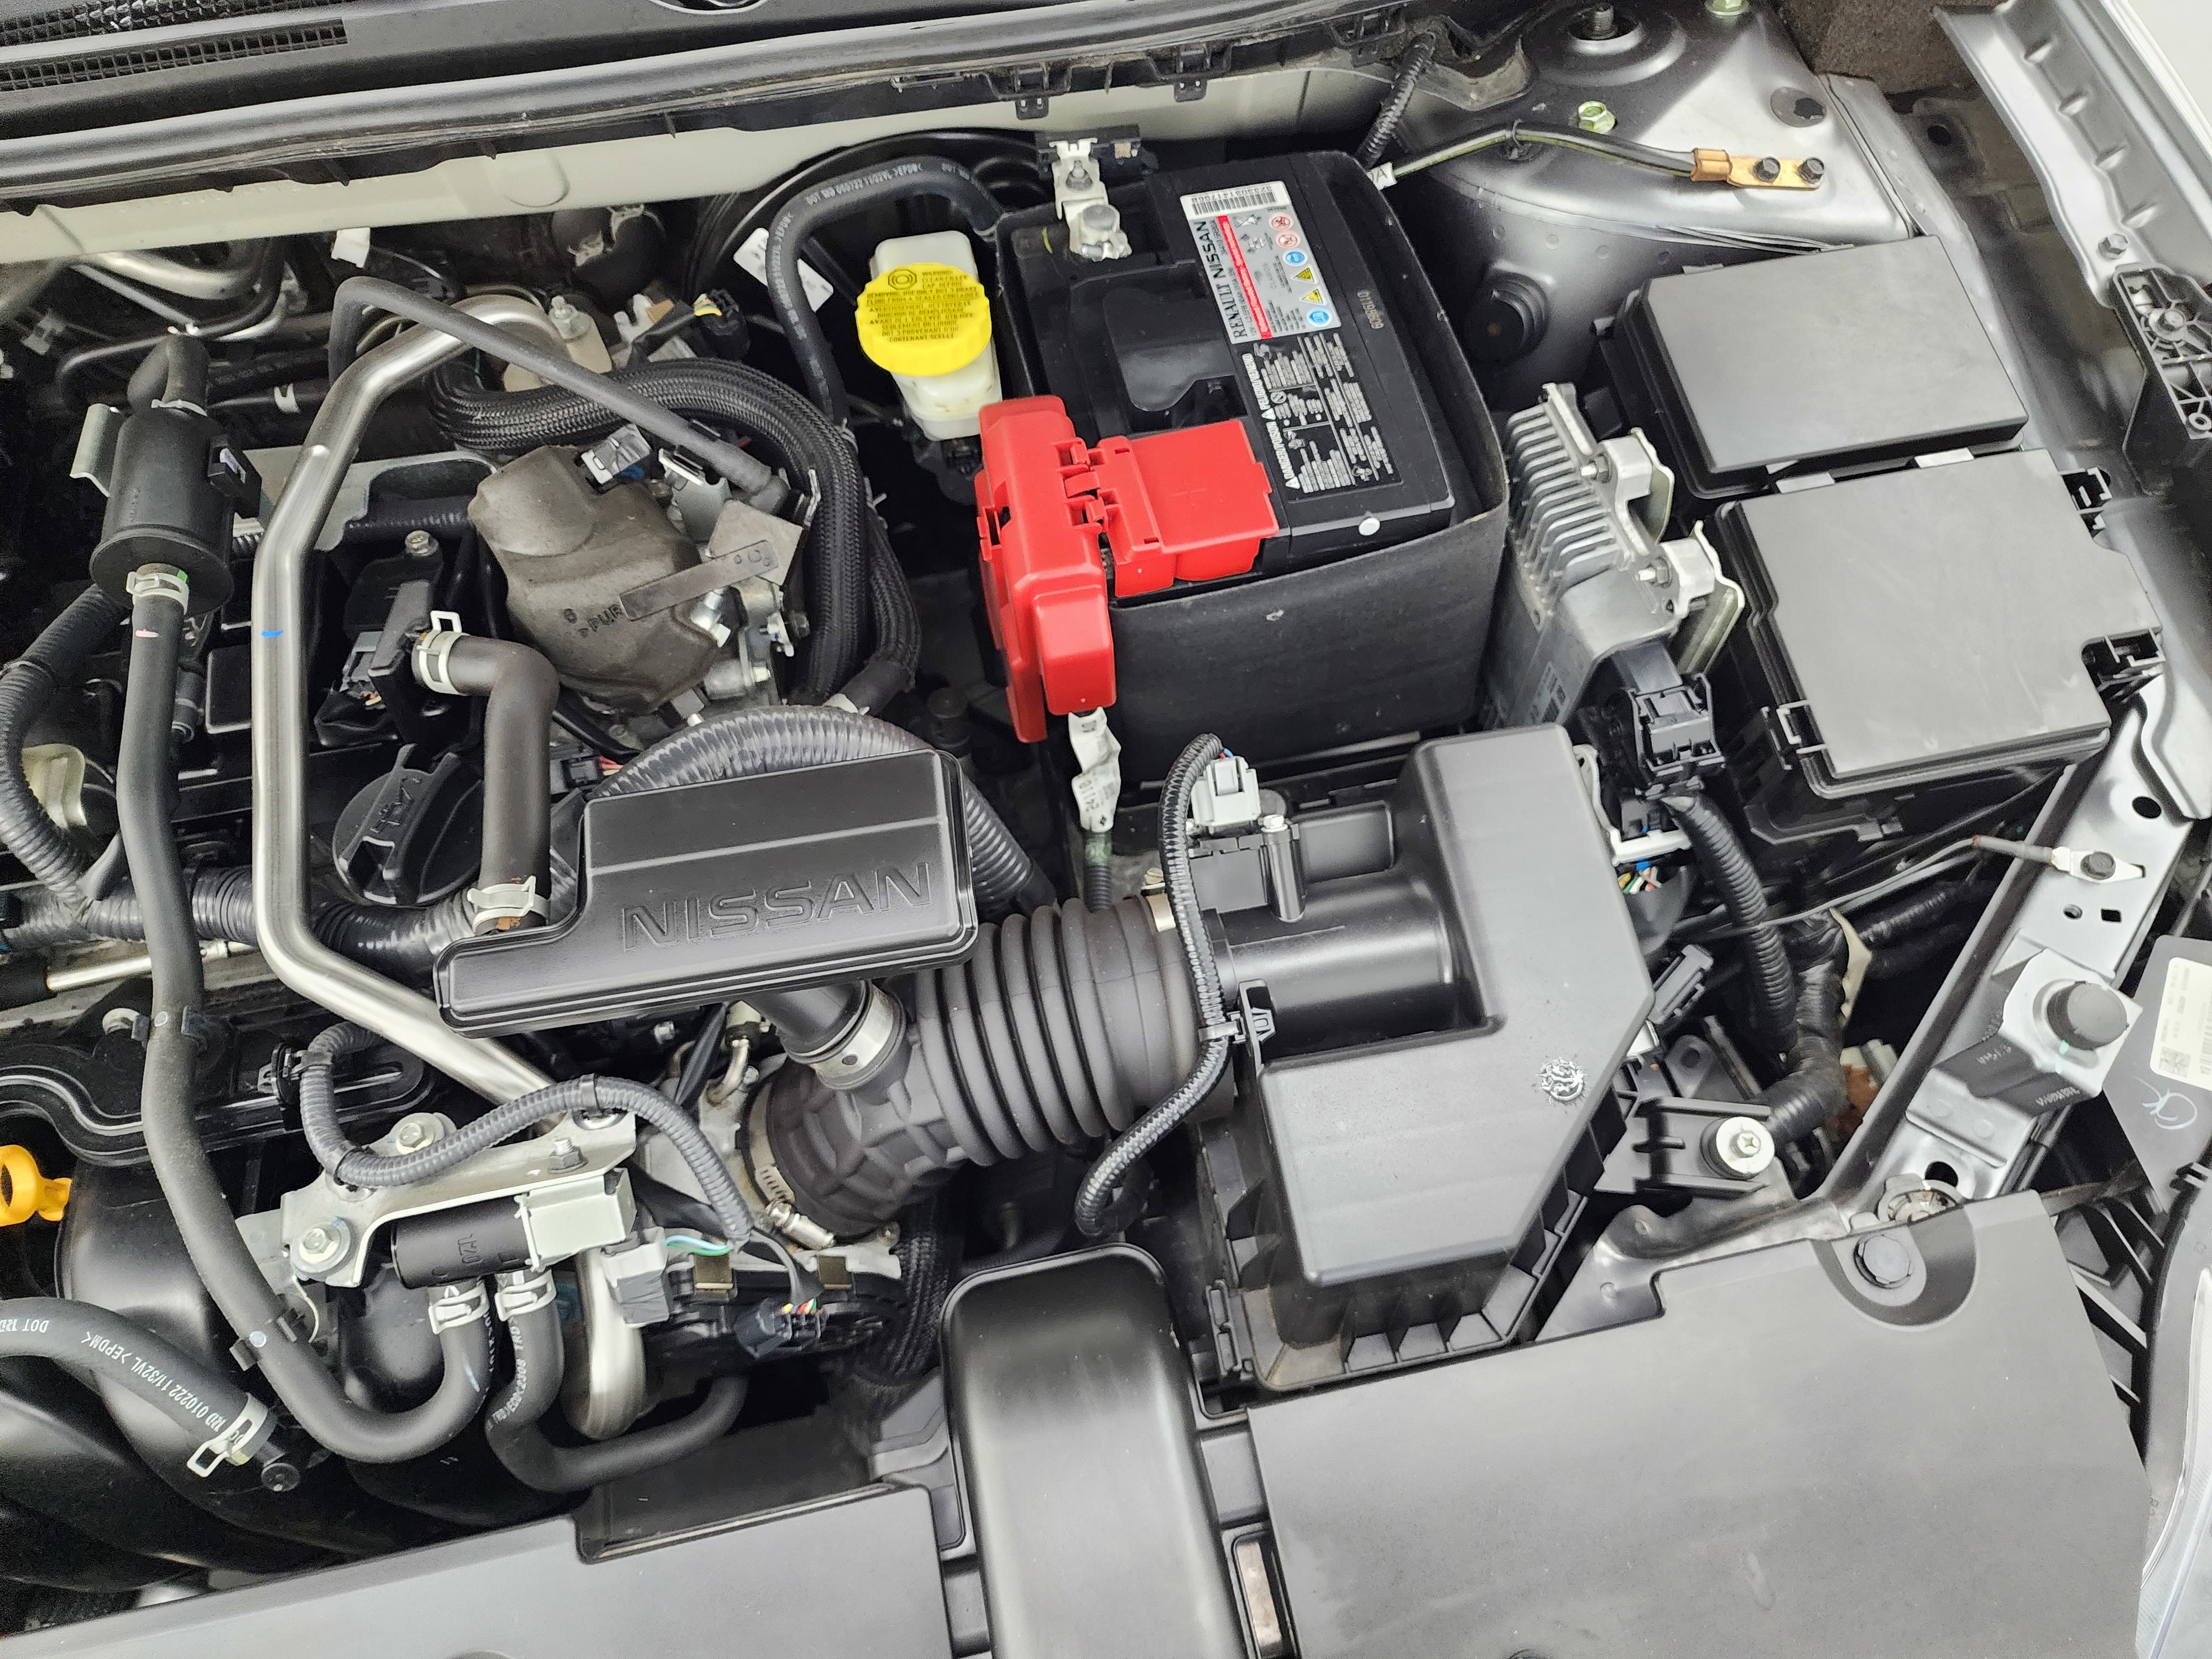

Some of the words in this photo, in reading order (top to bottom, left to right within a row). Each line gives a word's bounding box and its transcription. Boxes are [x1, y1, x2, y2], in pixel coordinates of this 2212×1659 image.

[1192, 220, 1226, 278] NISSAN
[1215, 283, 1248, 340] RENAULT
[1241, 352, 1271, 410] PELIGRO/VENENO
[1265, 420, 1295, 479] DANGER/POISON
[623, 861, 932, 952] NISSAN
[22, 1318, 49, 1333] DOT
[80, 1329, 133, 1364] >EPDM<
[128, 1355, 174, 1391] 11/32VL
[168, 1383, 211, 1418] 010222
[202, 1411, 227, 1432] RD
